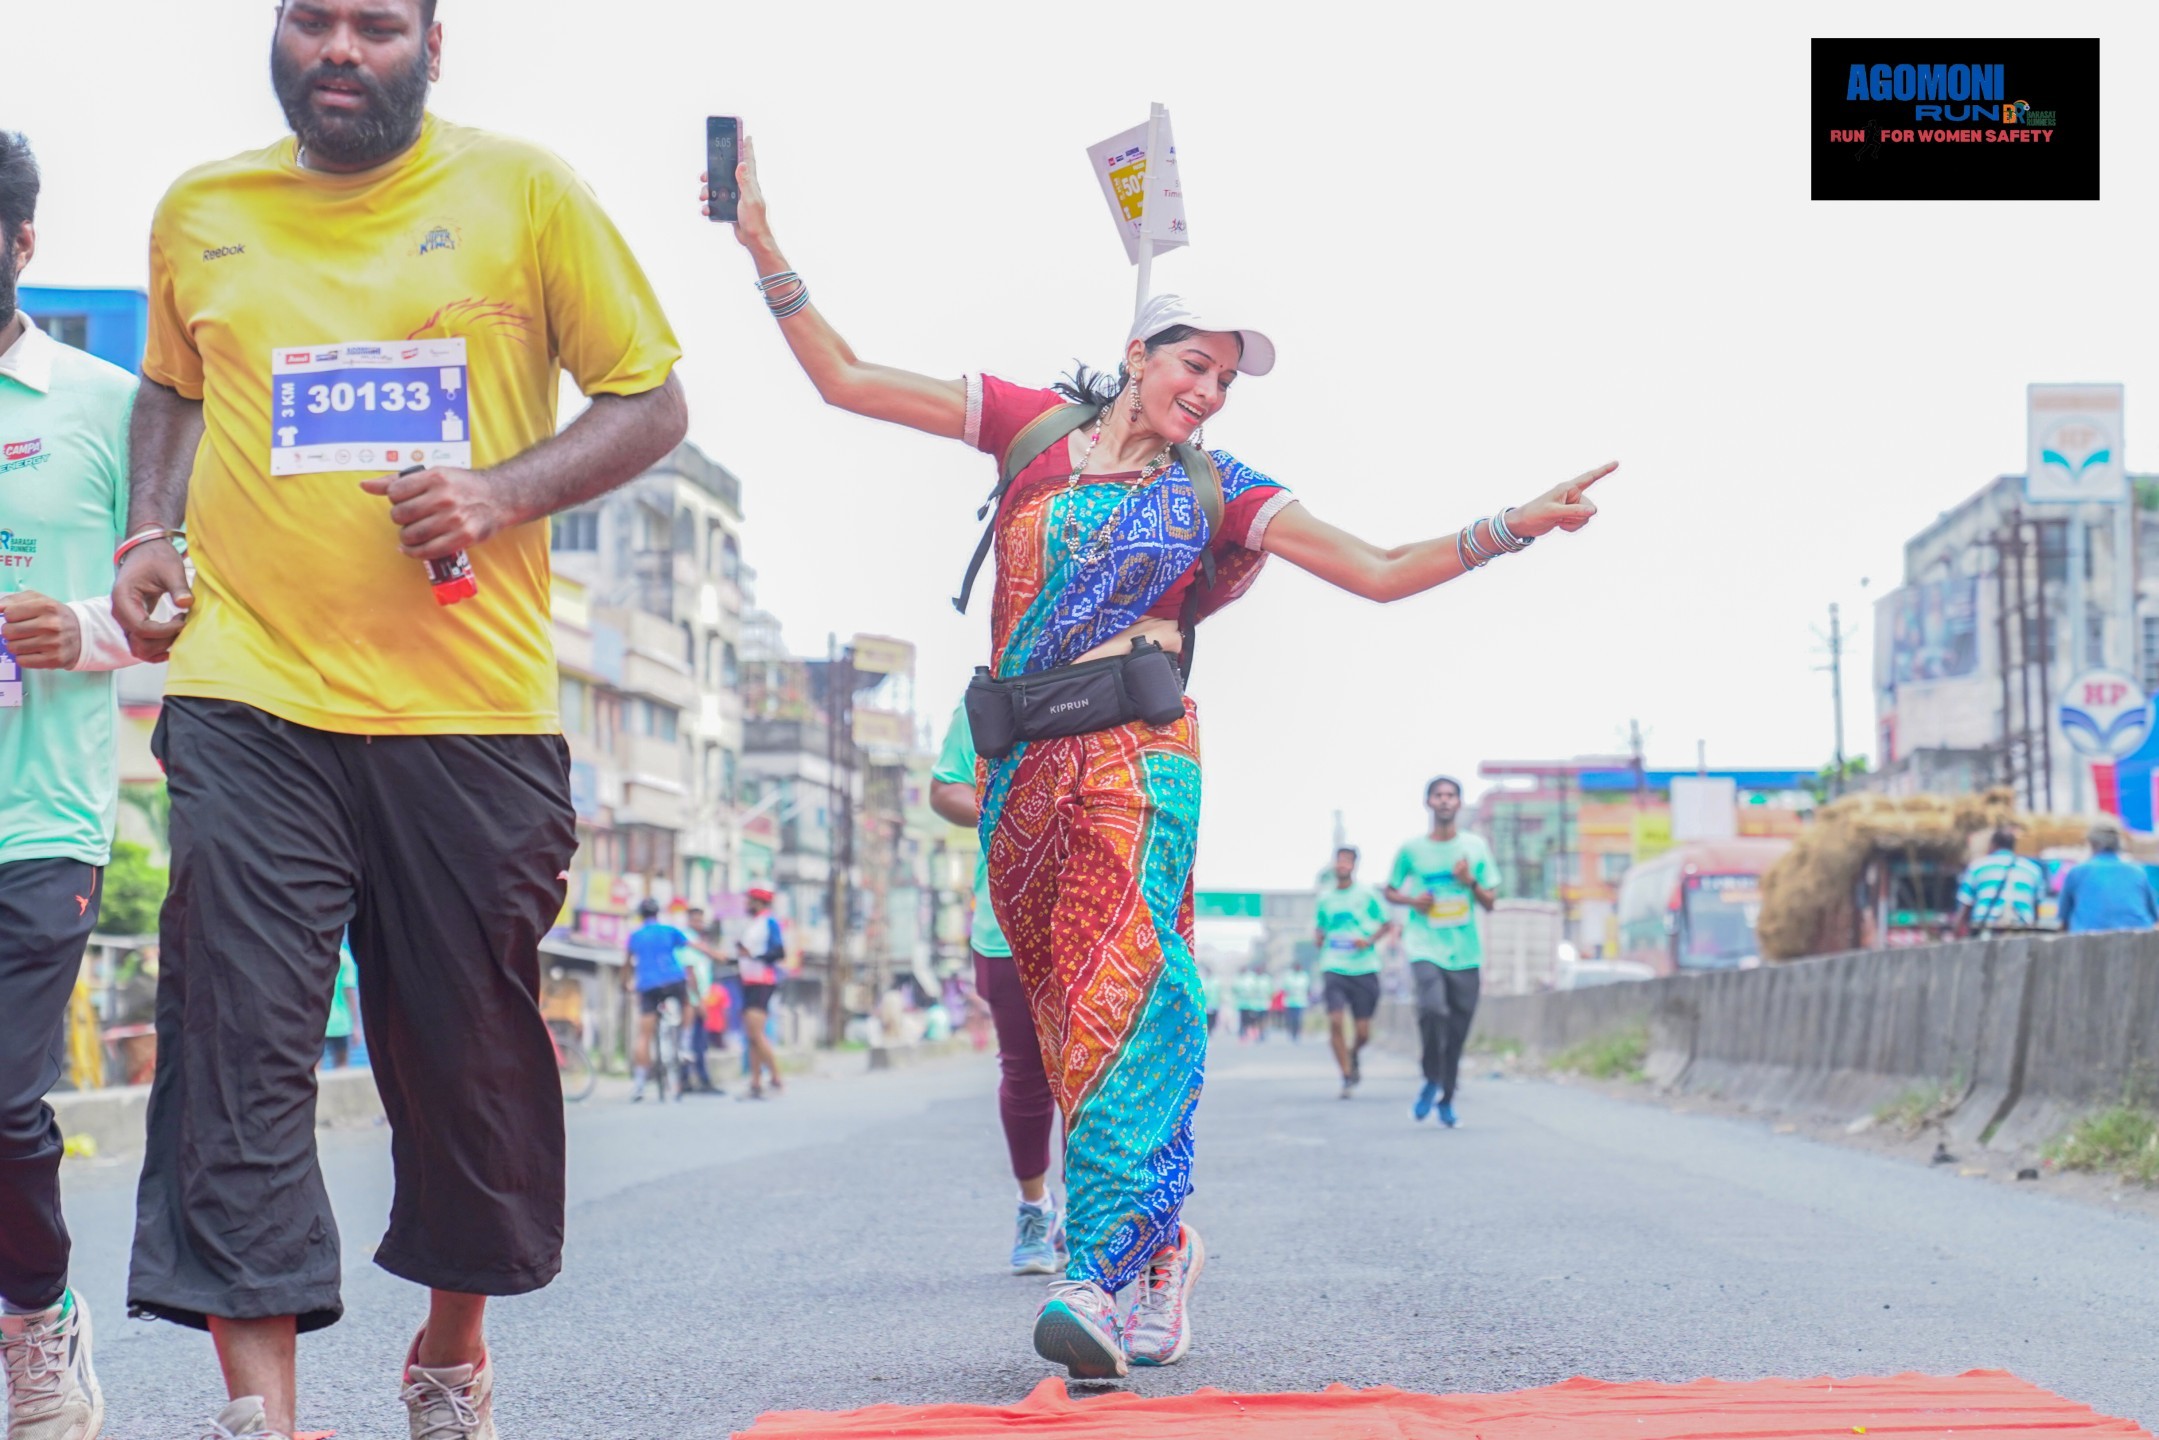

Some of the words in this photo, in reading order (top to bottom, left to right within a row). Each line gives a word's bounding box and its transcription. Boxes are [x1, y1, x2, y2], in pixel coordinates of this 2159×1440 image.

[281, 382, 296, 407] KM
[307, 381, 431, 414] 30133
[281, 408, 296, 418] 3
[5, 442, 41, 456] CAMPA
[2083, 682, 2128, 708] HP
[1050, 698, 1090, 714] KIPRUN
